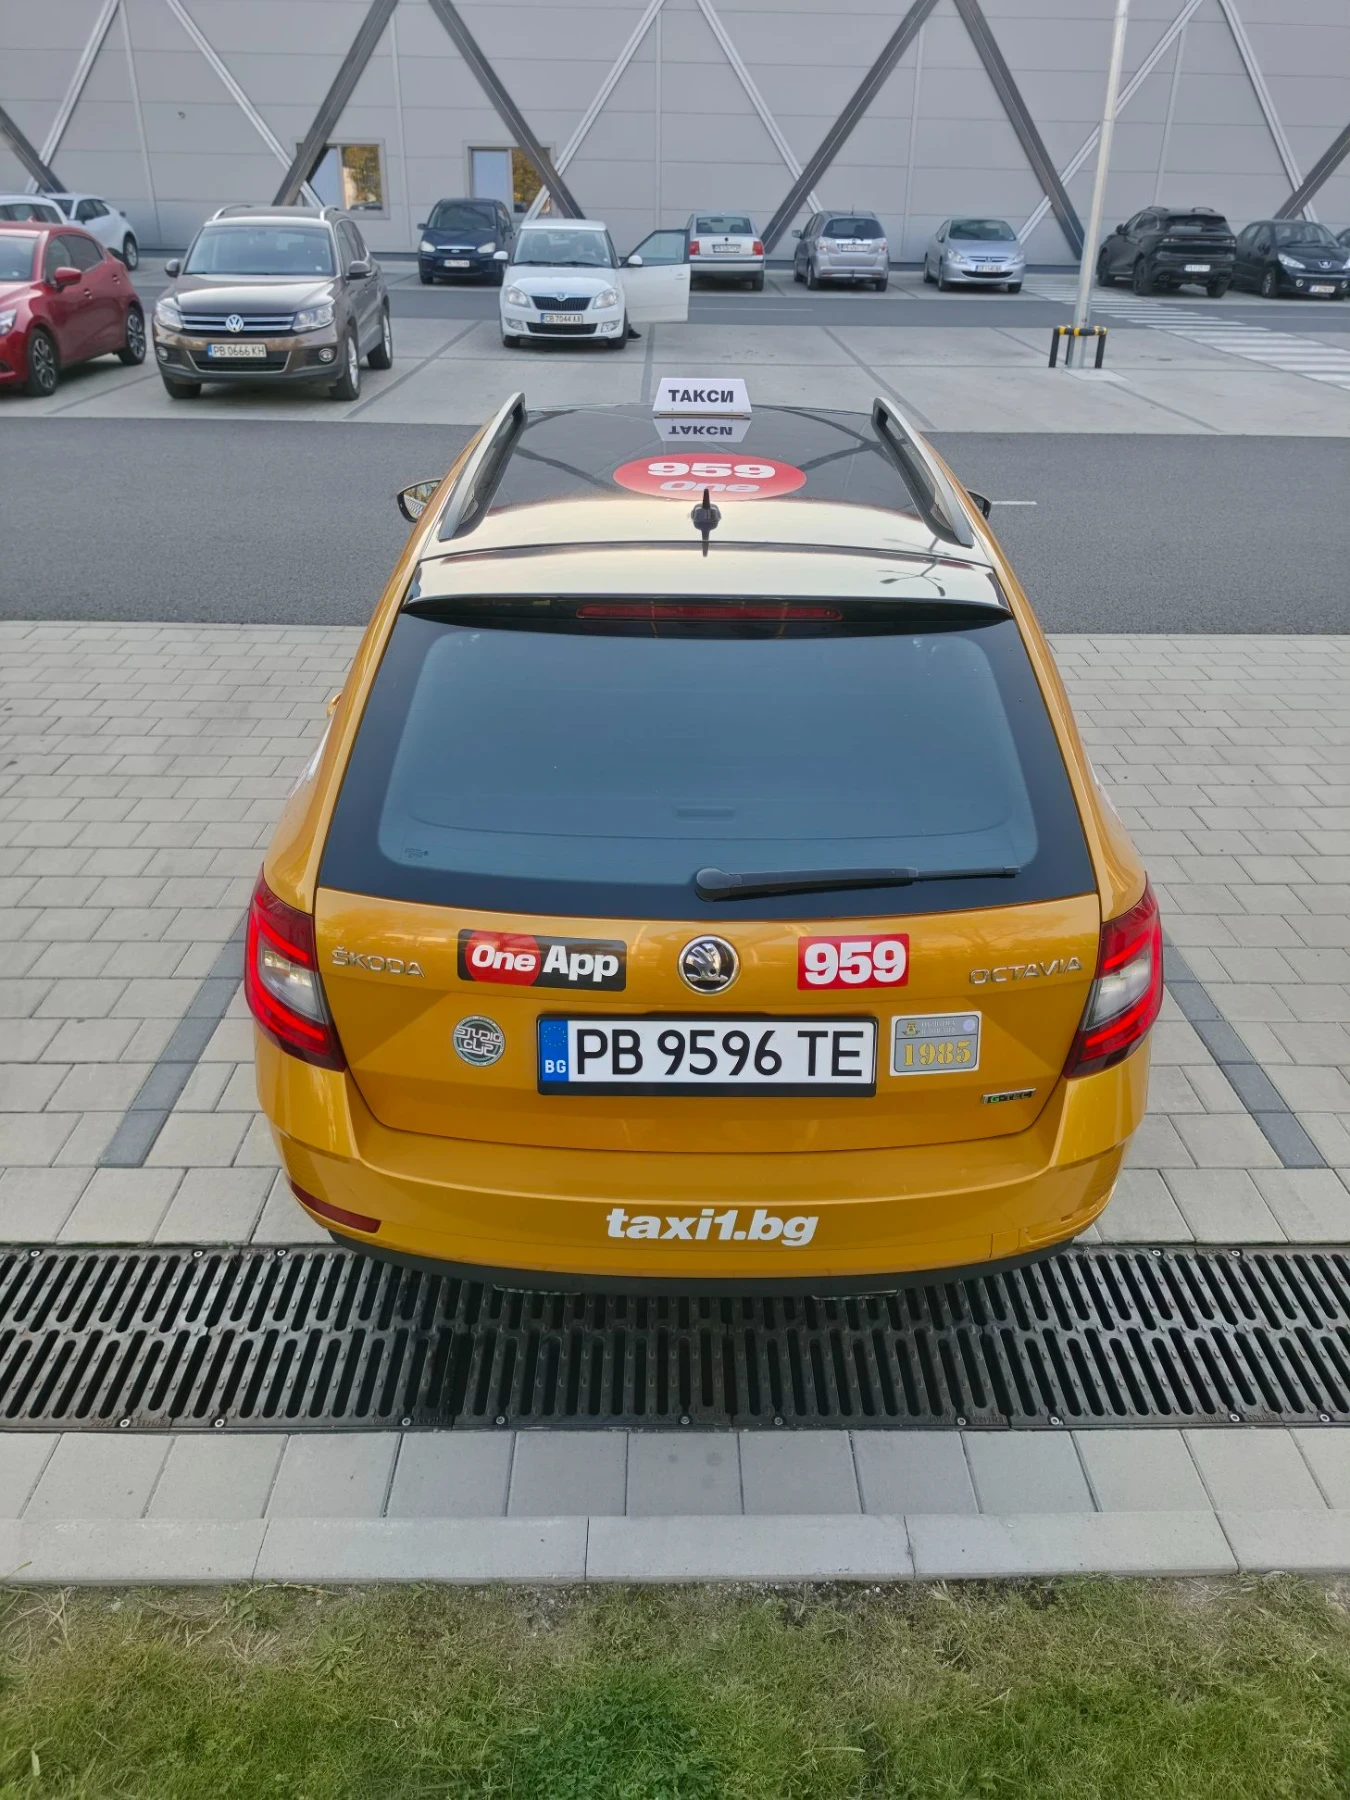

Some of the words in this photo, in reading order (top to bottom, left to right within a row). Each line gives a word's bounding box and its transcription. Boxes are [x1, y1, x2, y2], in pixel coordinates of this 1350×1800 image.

[213, 346, 226, 355] PB
[227, 345, 251, 356] 0666
[252, 344, 265, 355] KH
[668, 389, 734, 404] ТАКСИ
[648, 462, 776, 479] 959
[660, 480, 760, 493] One
[331, 946, 426, 978] ŠKODA
[471, 944, 537, 972] One
[542, 944, 620, 983] App
[804, 940, 906, 985] 959
[970, 956, 1082, 984] OCTAVIA
[577, 1029, 644, 1076] PB
[657, 1029, 783, 1077] 9596
[797, 1030, 863, 1077] TE
[903, 1040, 972, 1067] 1985
[545, 1060, 567, 1074] BG
[605, 1208, 819, 1247] taxi1.bg
